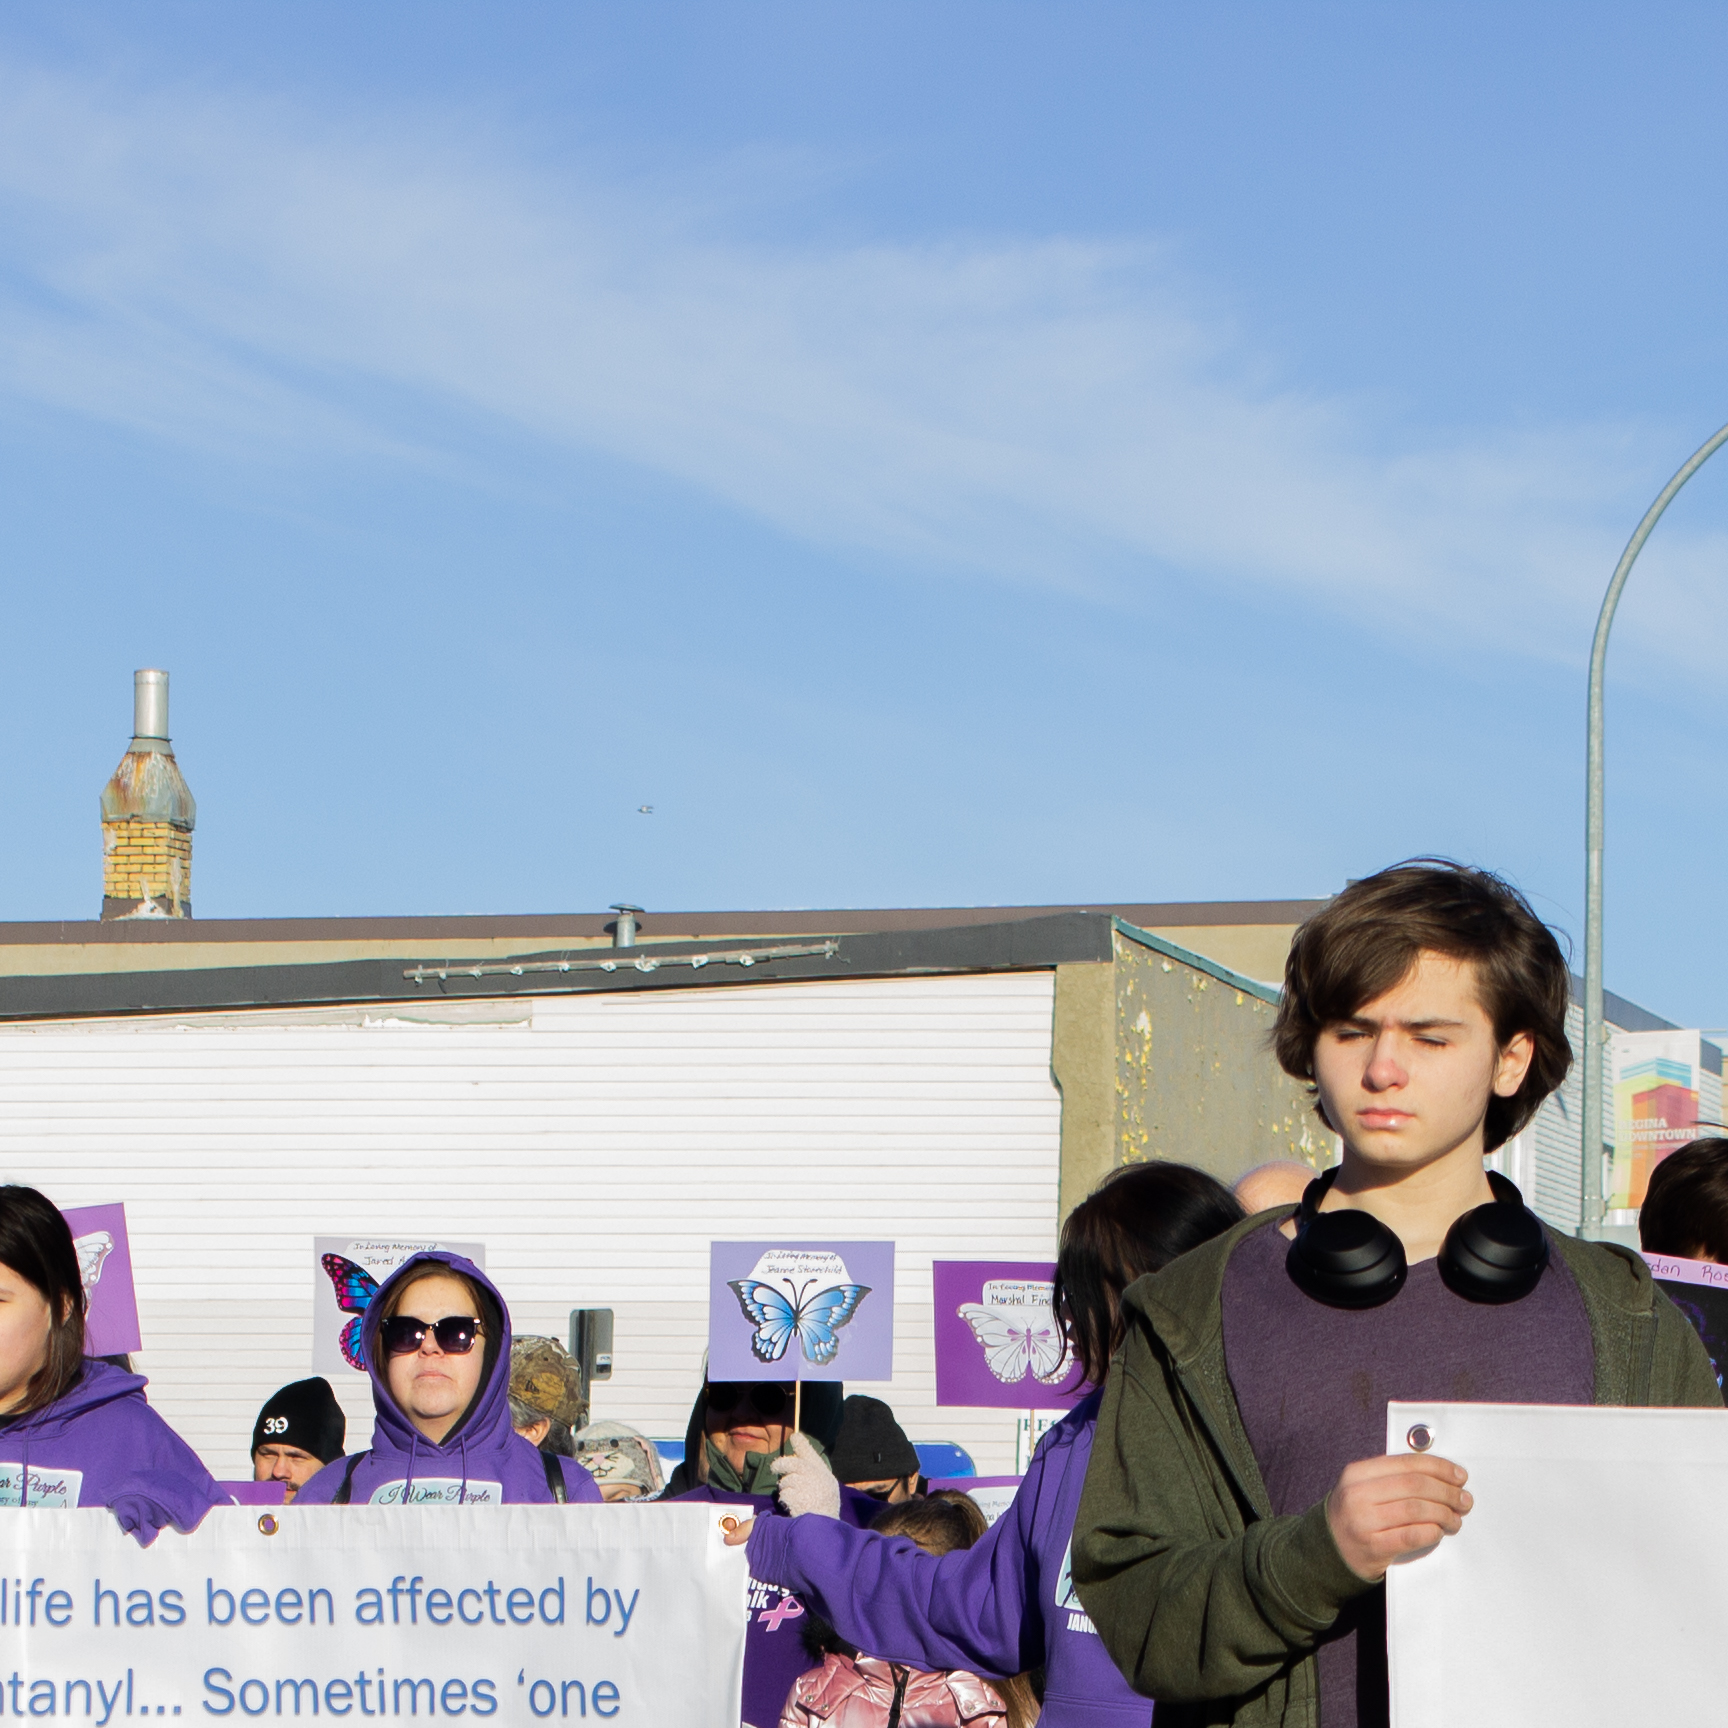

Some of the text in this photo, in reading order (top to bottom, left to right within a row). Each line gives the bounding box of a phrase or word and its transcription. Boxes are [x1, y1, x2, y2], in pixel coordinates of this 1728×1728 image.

[263, 1416, 289, 1435] 39
[13, 1473, 68, 1499] Purple
[401, 1484, 444, 1503] Wear
[0, 1577, 73, 1626] life
[93, 1578, 187, 1626] has
[206, 1577, 334, 1624] been
[354, 1575, 566, 1625] affected
[586, 1577, 641, 1636] by
[202, 1667, 498, 1716] Sometimes
